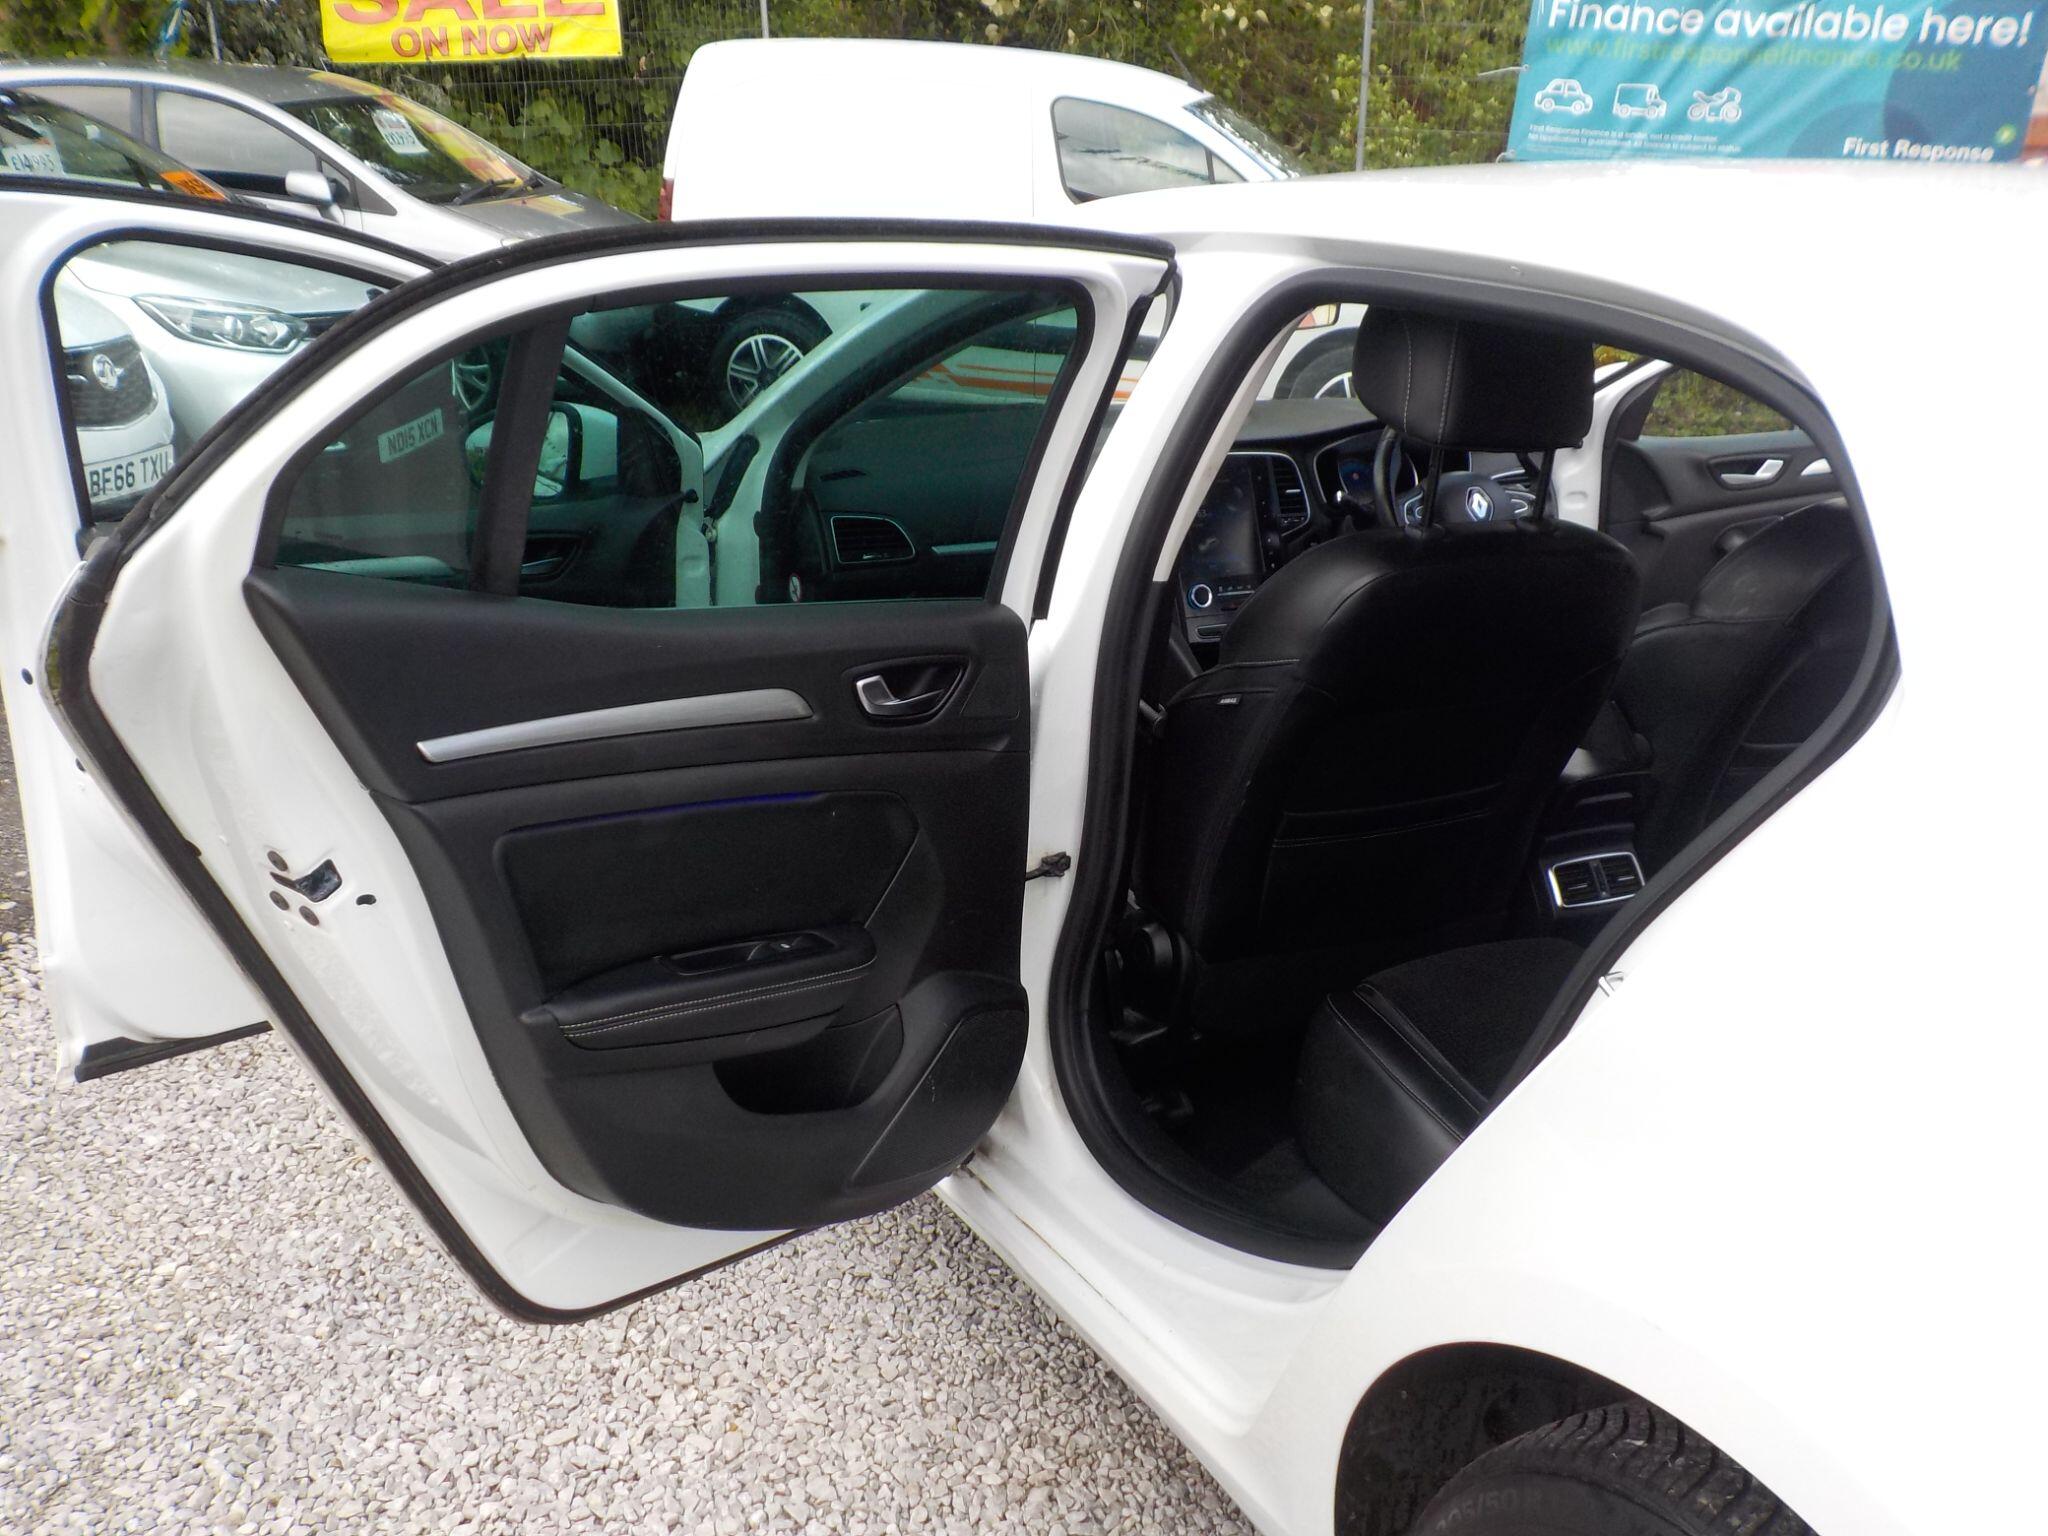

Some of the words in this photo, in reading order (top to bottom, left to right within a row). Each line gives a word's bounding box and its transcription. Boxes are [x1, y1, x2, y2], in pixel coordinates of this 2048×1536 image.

[391, 27, 449, 58] ON
[461, 23, 553, 56] NOW
[1549, 0, 1704, 35] Finance
[1713, 1, 1909, 42] available
[1918, 6, 2033, 47] here!
[1842, 136, 1889, 159] First
[1893, 138, 1994, 163] Response
[416, 413, 438, 443] XCN
[89, 461, 135, 497] BF66
